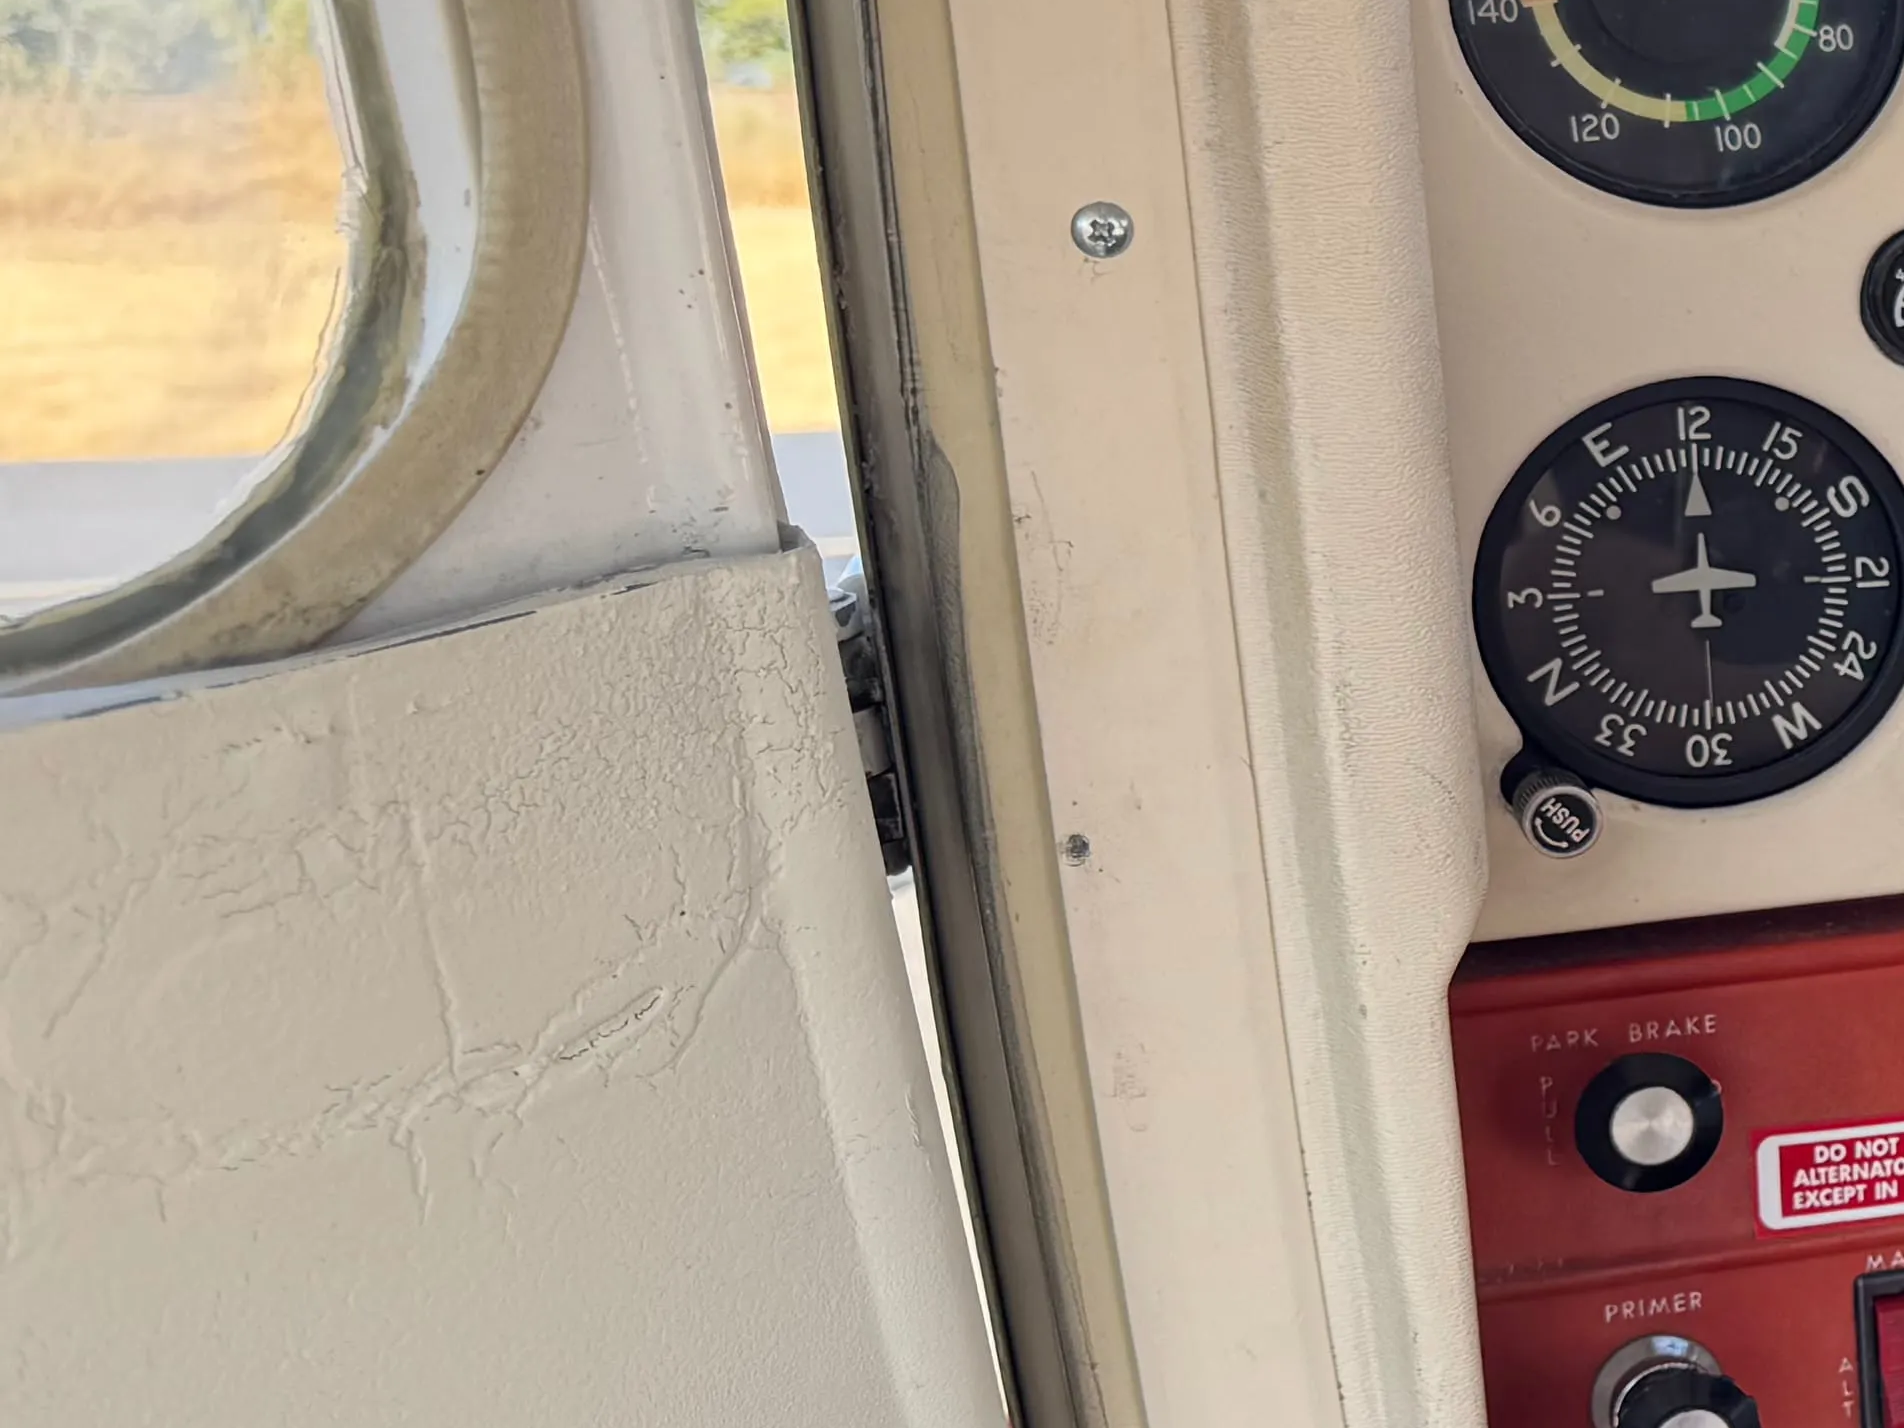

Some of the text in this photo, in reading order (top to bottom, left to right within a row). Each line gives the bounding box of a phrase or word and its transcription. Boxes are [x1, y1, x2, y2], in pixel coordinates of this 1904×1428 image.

[1817, 24, 1853, 52] 80
[1570, 114, 1620, 143] 120
[1714, 123, 1762, 152] 100
[1677, 406, 1712, 442] 12
[1540, 797, 1591, 842] PUSH
[1531, 1014, 1717, 1052] PARK BRAKE
[1814, 1145, 1847, 1165] DO
[1855, 1137, 1900, 1160] NOT
[1792, 1183, 1868, 1211] EXCEPT
[1875, 1179, 1898, 1201] IN
[1604, 1291, 1704, 1323] PRIMER
[1839, 1357, 1854, 1418] ALT
